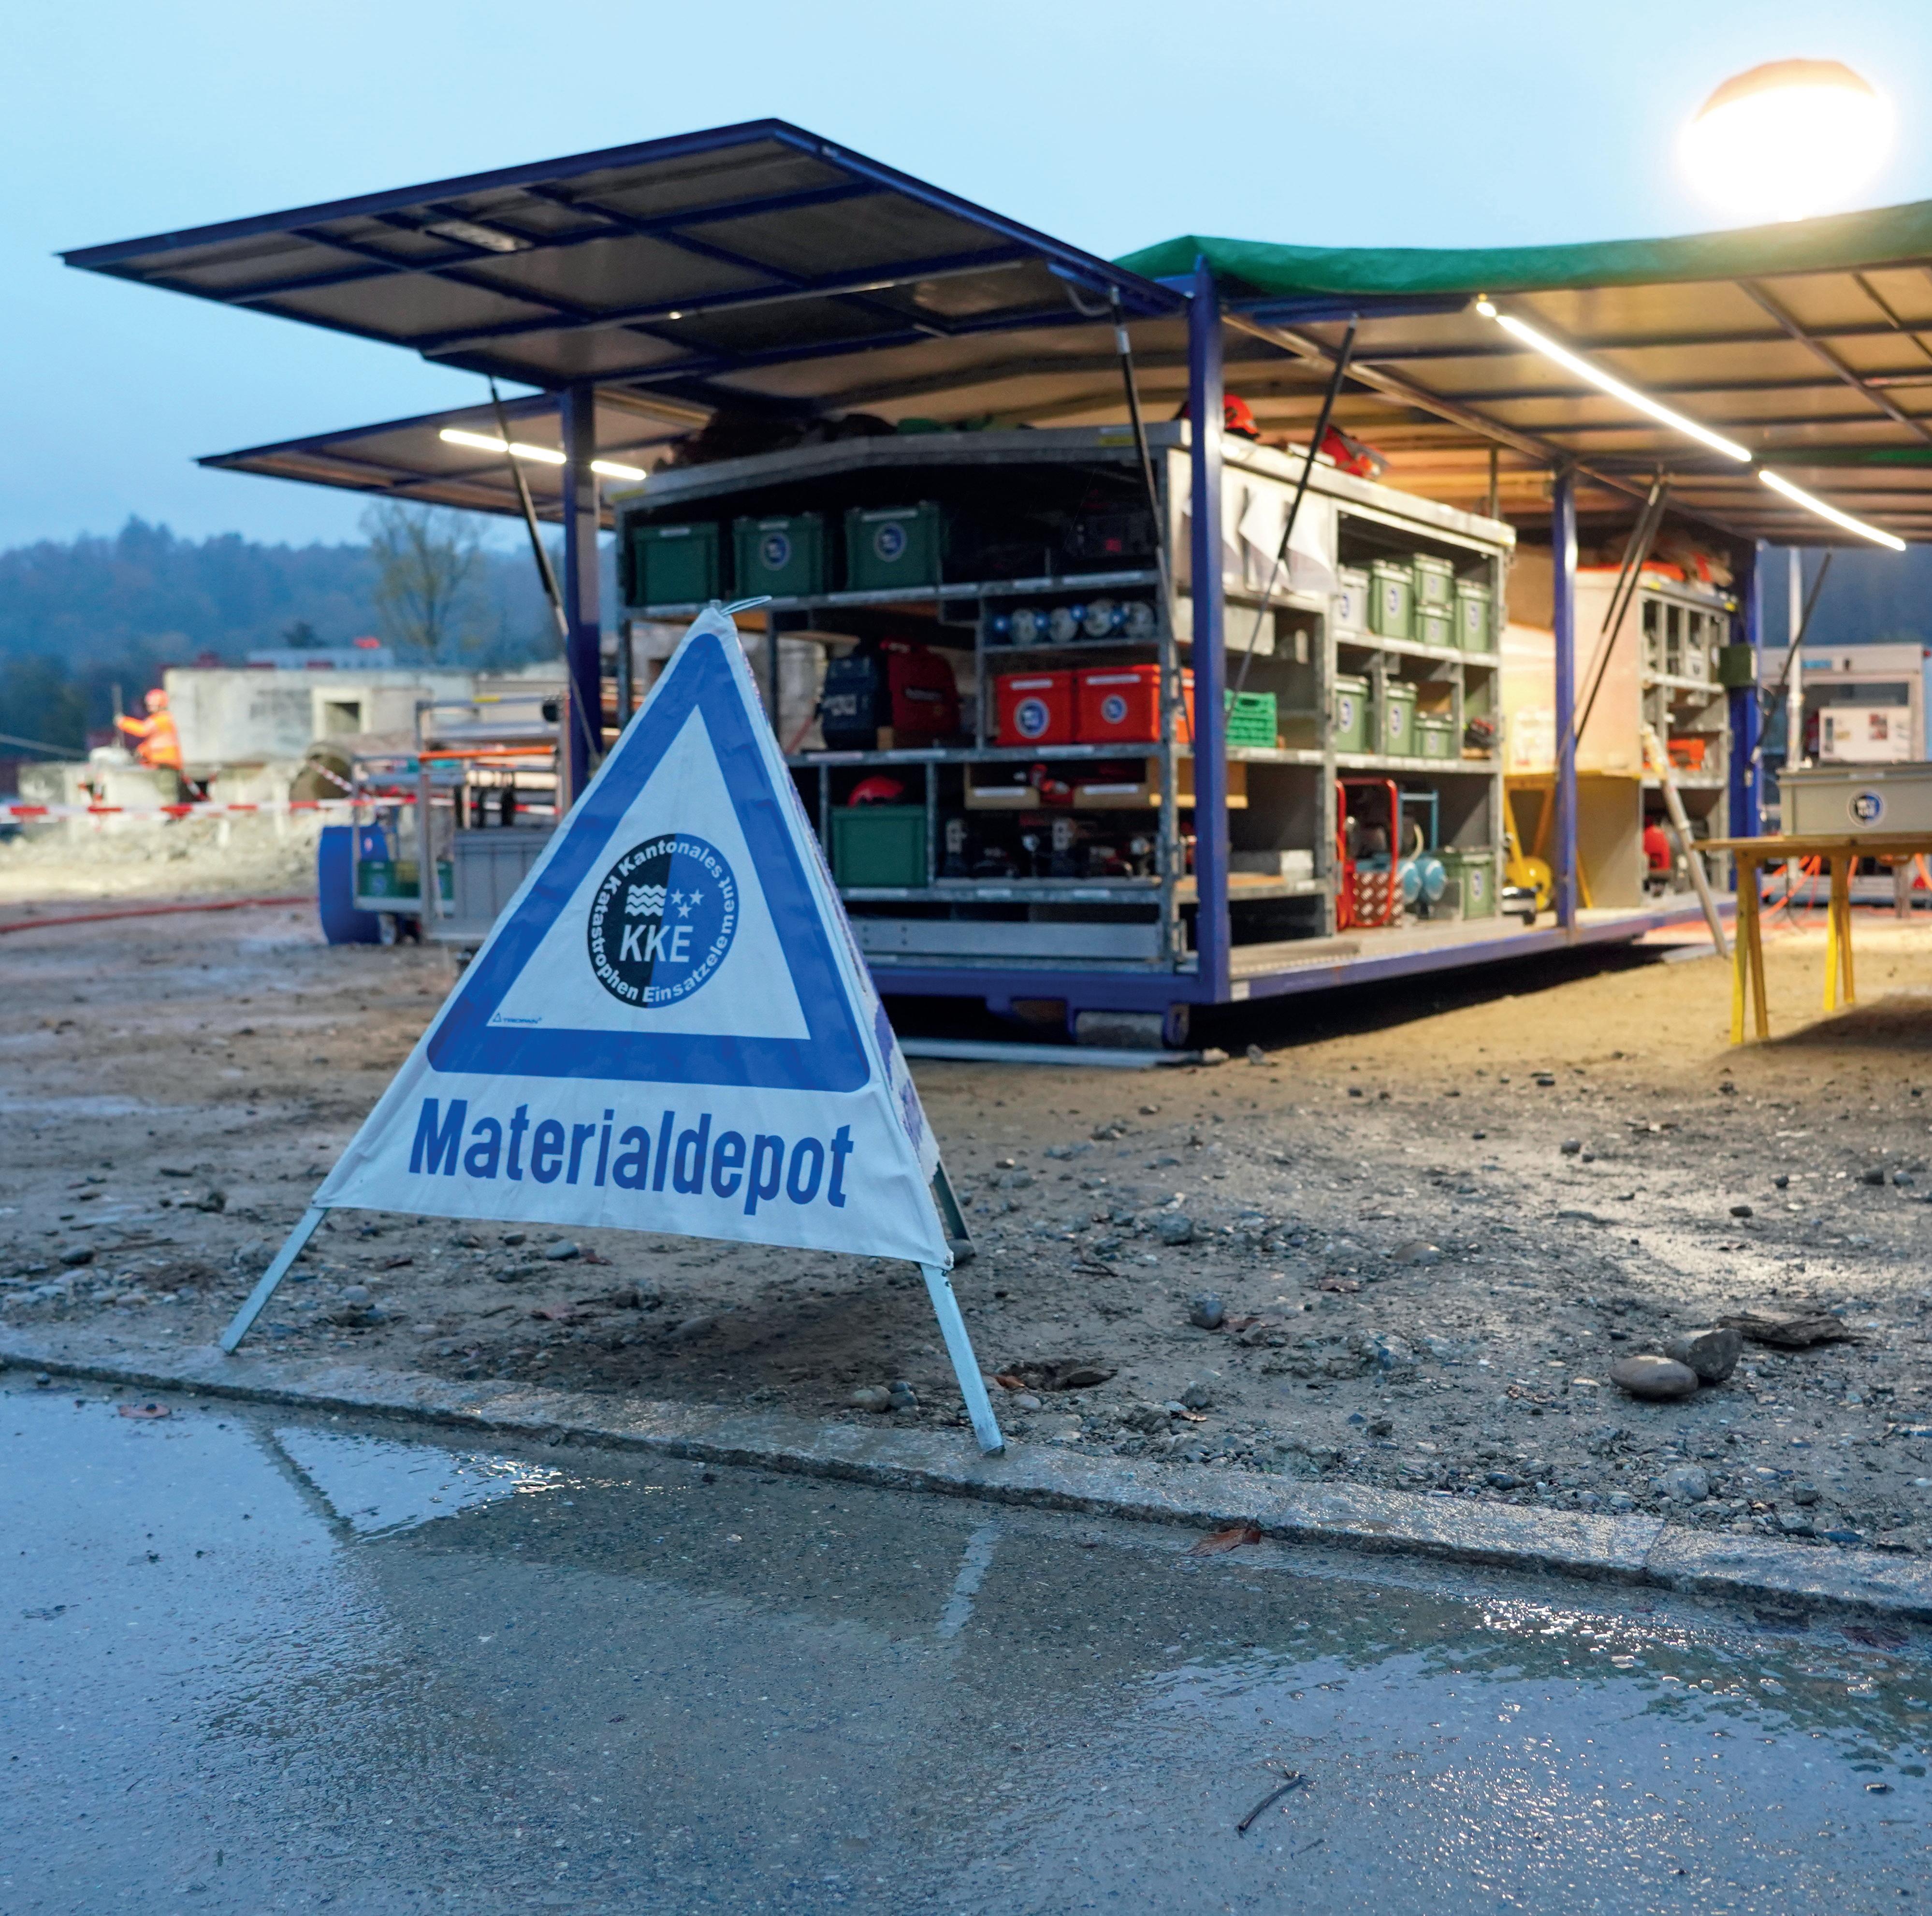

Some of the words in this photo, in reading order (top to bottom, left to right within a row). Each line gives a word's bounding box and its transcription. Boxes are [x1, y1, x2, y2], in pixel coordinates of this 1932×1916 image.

[619, 840, 722, 878] Kantonales
[592, 876, 639, 1000] Katastrophen
[620, 925, 693, 962] KKE
[642, 877, 734, 1002] Einsatzelement
[409, 1098, 854, 1216] Materialdepot
